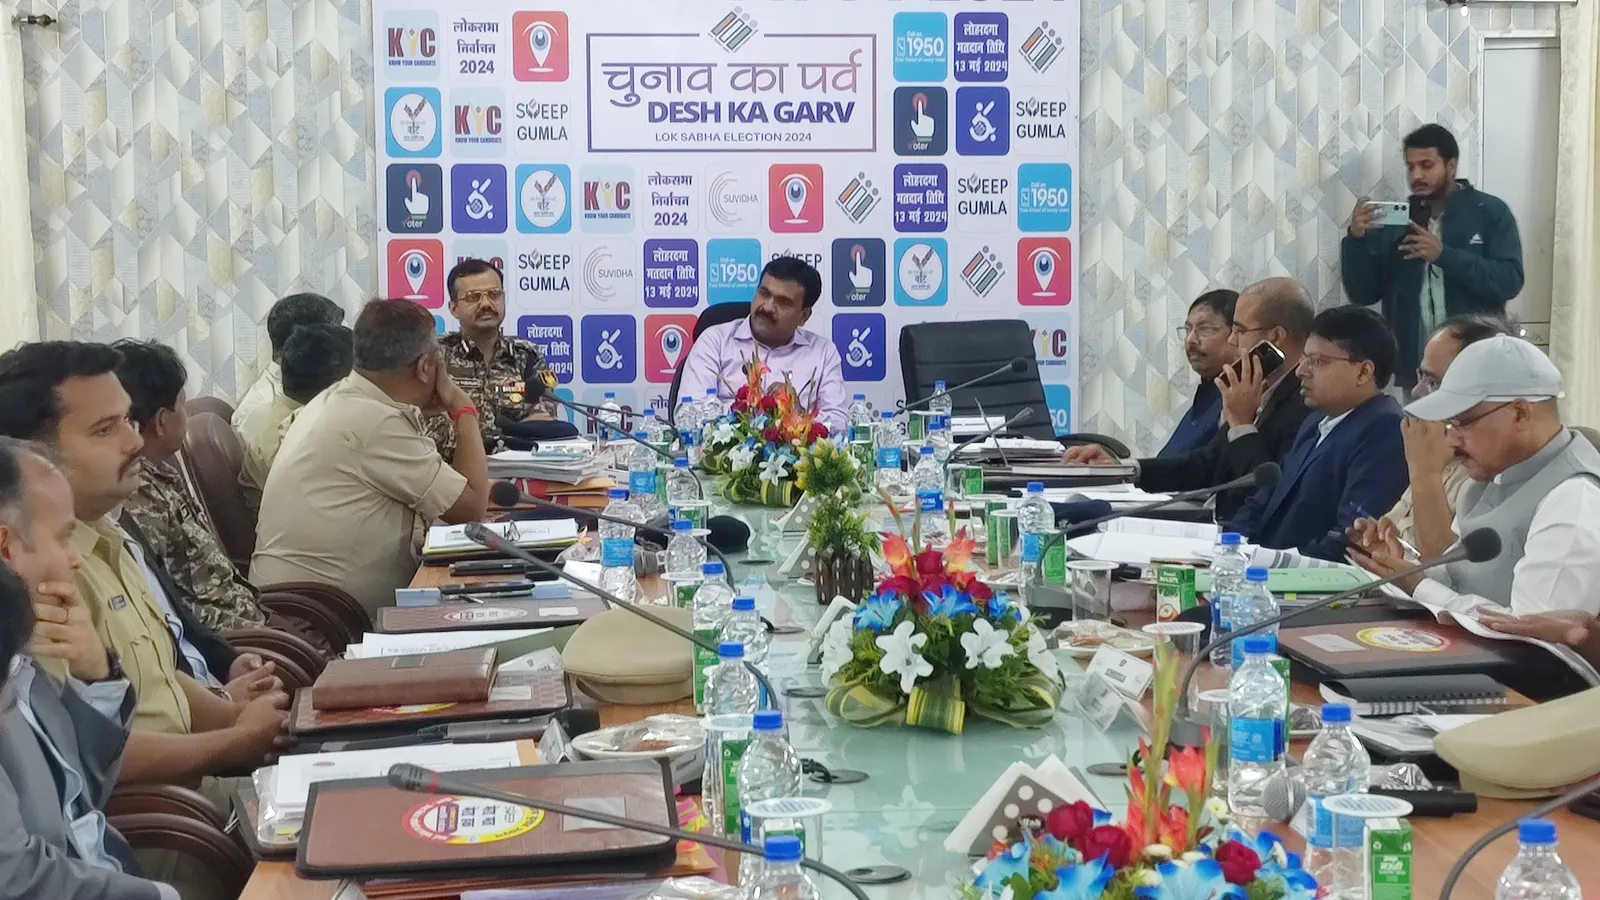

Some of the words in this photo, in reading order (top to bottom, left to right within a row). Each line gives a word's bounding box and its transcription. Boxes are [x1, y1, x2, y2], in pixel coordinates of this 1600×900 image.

[388, 25, 436, 58] KYC
[456, 39, 496, 54] निर्वाचन
[907, 38, 944, 56] 1950
[956, 42, 984, 54] मतदान
[986, 40, 1005, 53] तिथि
[460, 60, 494, 74] 2024
[954, 61, 965, 72] 13
[969, 57, 980, 73] मई
[984, 60, 1008, 72] 2024
[602, 63, 717, 108] चुनाव
[727, 63, 789, 94] का
[797, 48, 862, 94] पर्व
[516, 101, 568, 119] SWEEP
[648, 102, 721, 123] DESH
[728, 102, 768, 123] KA
[774, 101, 855, 124] GARV
[1016, 100, 1066, 117] SWEEP
[454, 104, 502, 135] KYC
[517, 126, 568, 140] GUMLA
[655, 132, 678, 142] LOK
[680, 132, 721, 142] SABHA
[724, 132, 782, 142] ELECTION
[784, 132, 812, 142] 2024
[1016, 124, 1066, 138] GUMLA
[958, 177, 1008, 194] SWEEP
[584, 179, 630, 210] KYC
[651, 192, 689, 206] निर्वाचन
[724, 194, 758, 203] SUVIDHA
[896, 192, 924, 204] मतदान
[926, 190, 945, 204] तिथि
[1031, 188, 1068, 207] 1950
[958, 200, 1007, 215] GUMLA
[654, 212, 688, 226] 2024
[895, 211, 905, 223] 13
[908, 208, 921, 224] मई
[924, 211, 947, 222] 2024
[518, 252, 570, 270] SWEEP
[598, 269, 633, 278] SUVIDHA
[646, 268, 674, 280] मतदान
[676, 265, 695, 279] तिथि
[720, 264, 758, 282] 1950
[520, 276, 570, 291] GUMLA
[645, 286, 656, 298] 13
[658, 283, 671, 299] मई
[675, 286, 698, 298] 2024
[551, 342, 570, 356] तिथि
[1031, 325, 1066, 357] YC
[549, 362, 572, 374] 2024
[587, 406, 632, 434] KC
[1049, 408, 1067, 427] 50
